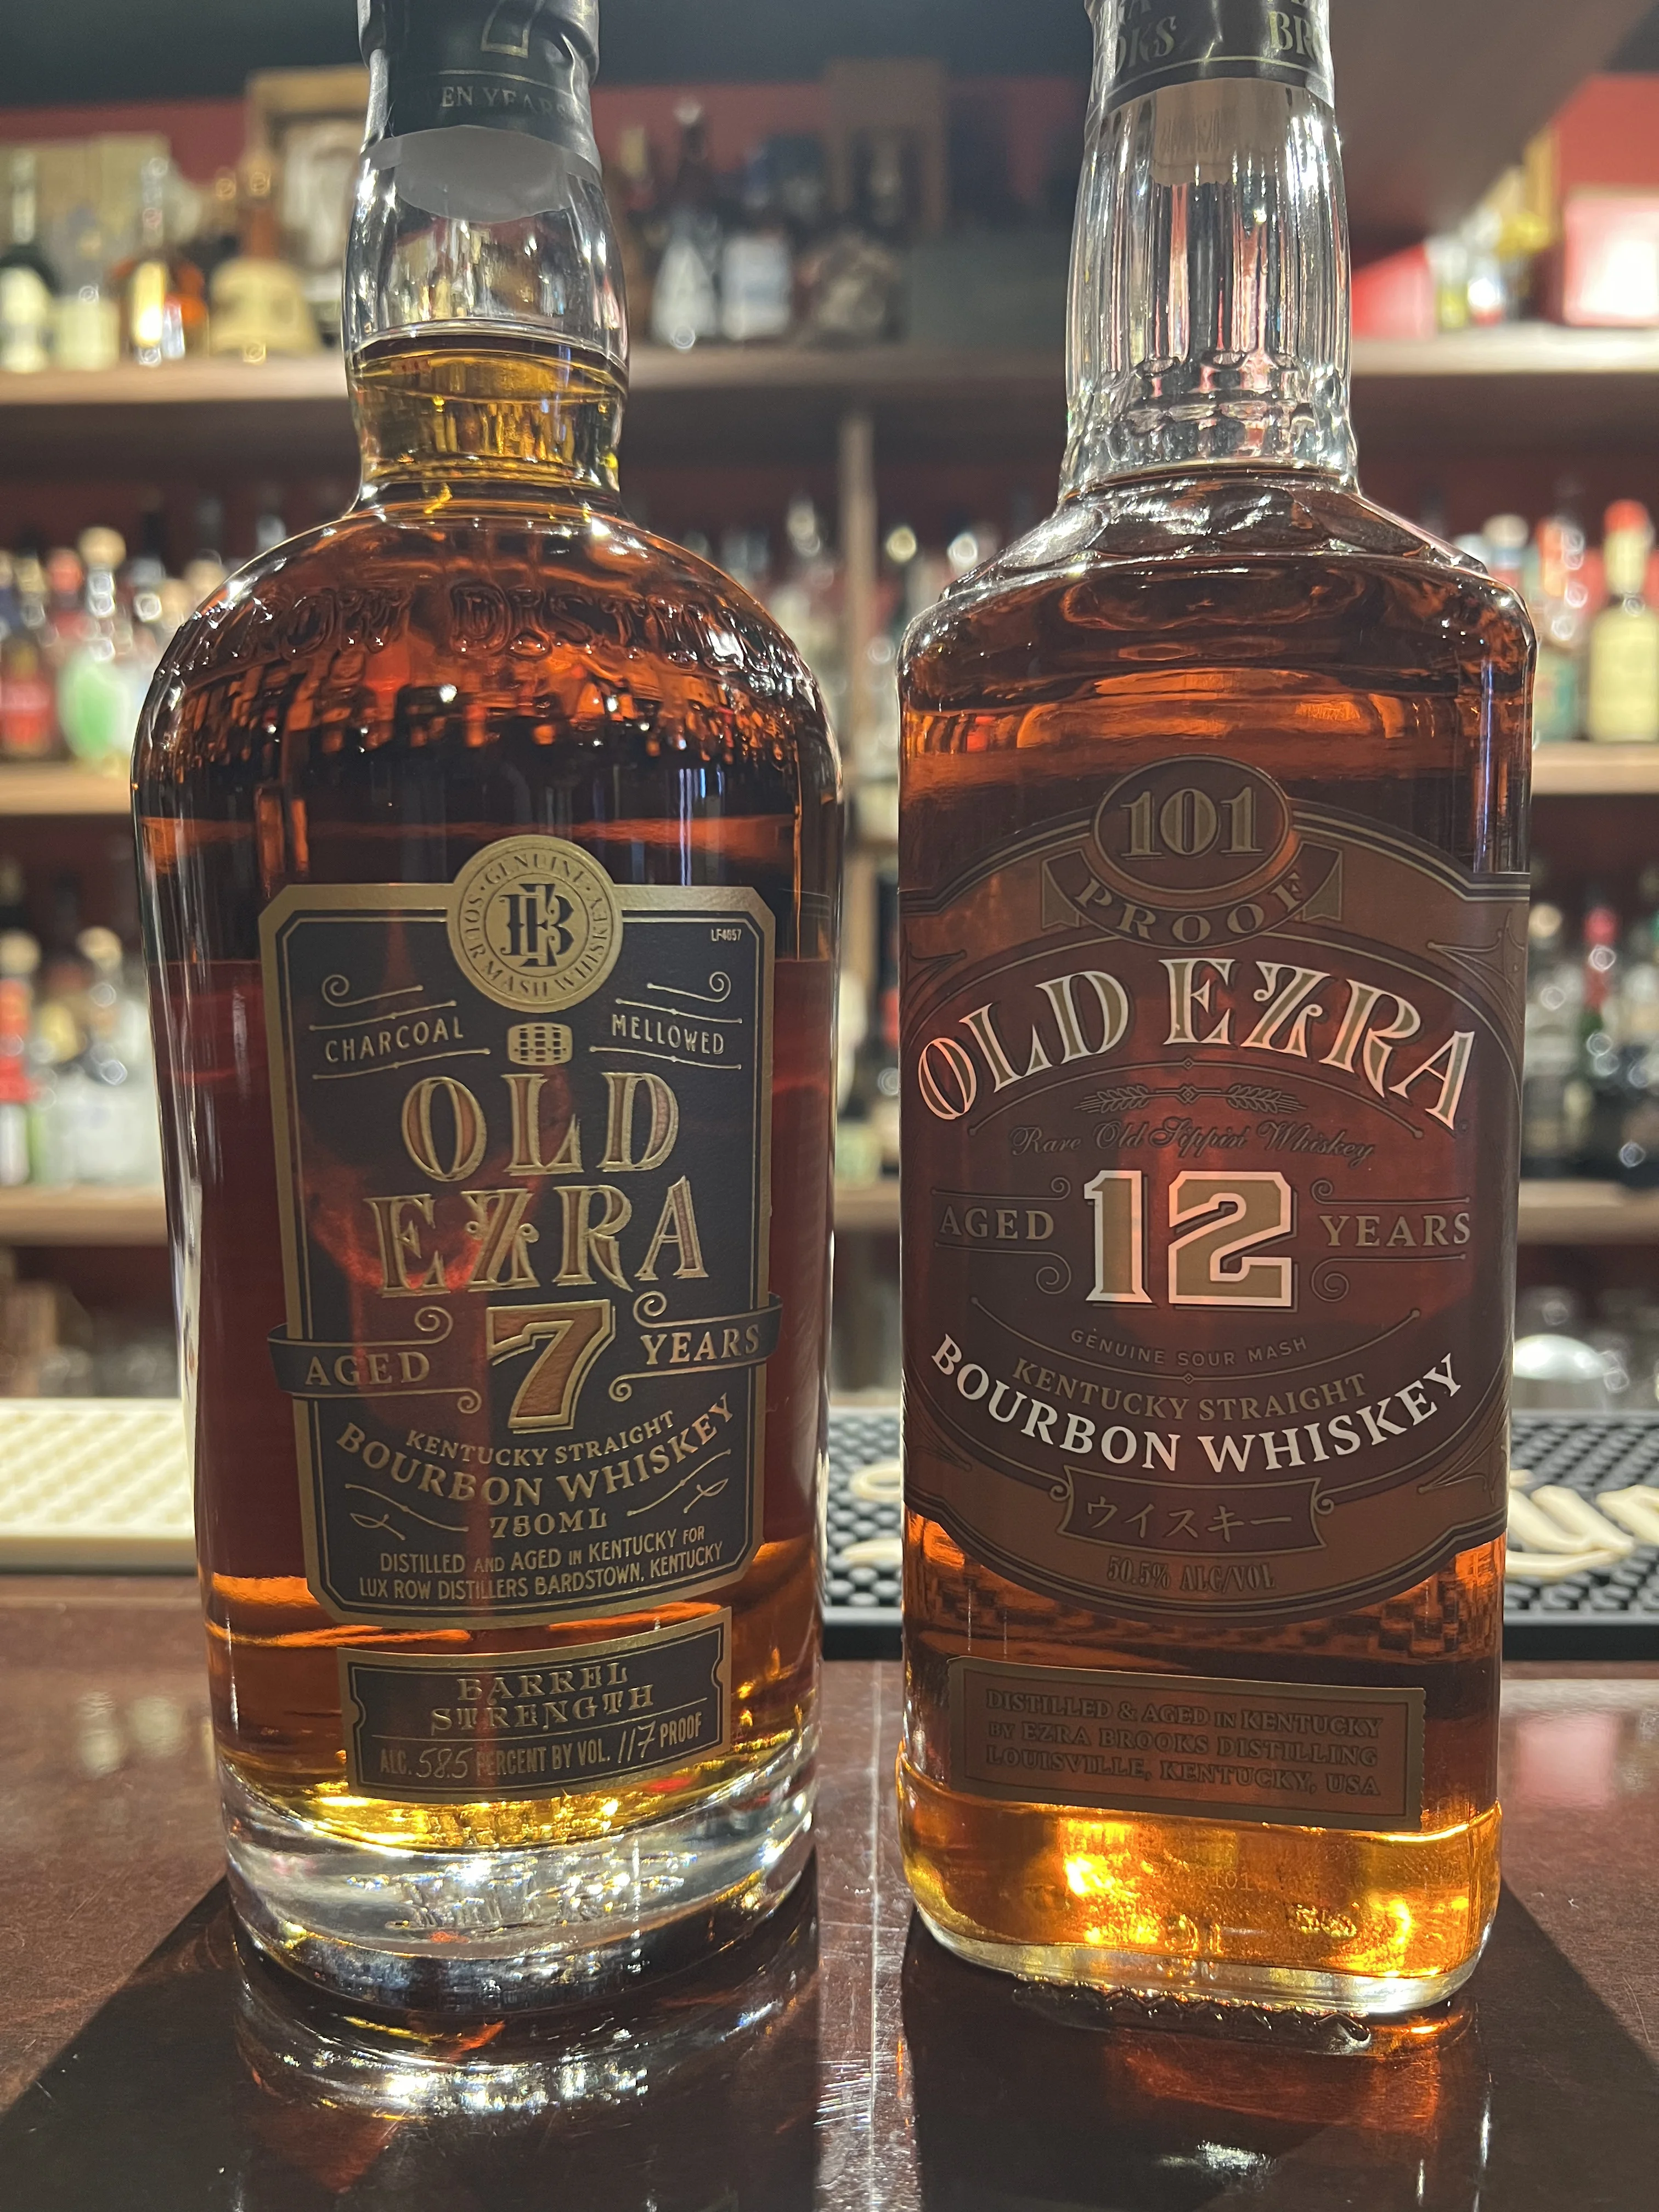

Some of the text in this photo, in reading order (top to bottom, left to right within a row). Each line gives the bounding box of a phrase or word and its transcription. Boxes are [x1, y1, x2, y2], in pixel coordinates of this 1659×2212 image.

[1120, 787, 1266, 861] 101
[1074, 872, 1303, 944] PROOF
[465, 893, 487, 959] SOUR
[483, 960, 548, 996] MASH
[325, 1014, 725, 1063] CHARCOAL MELLOWED
[917, 958, 1477, 1130] OLD EZRA
[401, 1071, 680, 1182] OLD
[1012, 1126, 1081, 1156] Rare
[1092, 1119, 1148, 1150] Old
[1257, 1119, 1376, 1168] Whiskey
[363, 1175, 709, 1298] EZRA
[939, 1170, 1471, 1312] AGED 12 YEARS
[304, 1299, 761, 1434] AGED 7 YEARS
[1070, 1329, 1307, 1367] GENUINE SOUR MASH
[931, 1333, 1462, 1472] BOURBON WHISKEY
[1012, 1357, 1365, 1421] KENTUCKY STRAIGHT
[336, 1392, 733, 1505] BOURBON WHISKEY
[406, 1409, 674, 1466] KENTUCKY STRAIGHT
[1087, 1496, 1293, 1543] ウイスキー
[359, 1541, 723, 1600] LUX ROW DISTILLERS BARDSTOWN, KENTUCKY
[380, 1525, 705, 1573] DISTILLED AND AGED IN KENTUCKY FOR
[1107, 1556, 1276, 1594] 50.5% ALC/VOL
[456, 1662, 629, 1704] BARREL
[430, 1684, 654, 1736] STRENGTH
[659, 1711, 703, 1748] PROOF
[986, 1689, 1383, 1738] DISTILLED & AGED IN KENTUCKY
[380, 1747, 412, 1775] ALC.
[476, 1738, 611, 1776] PERCENT BY VOL.
[617, 1720, 657, 1764] 117
[989, 1722, 1379, 1767] BY EZRA BROOKS DISTILLING
[986, 1745, 1381, 1795] LOUISVILLE, KENTUCKY, USA
